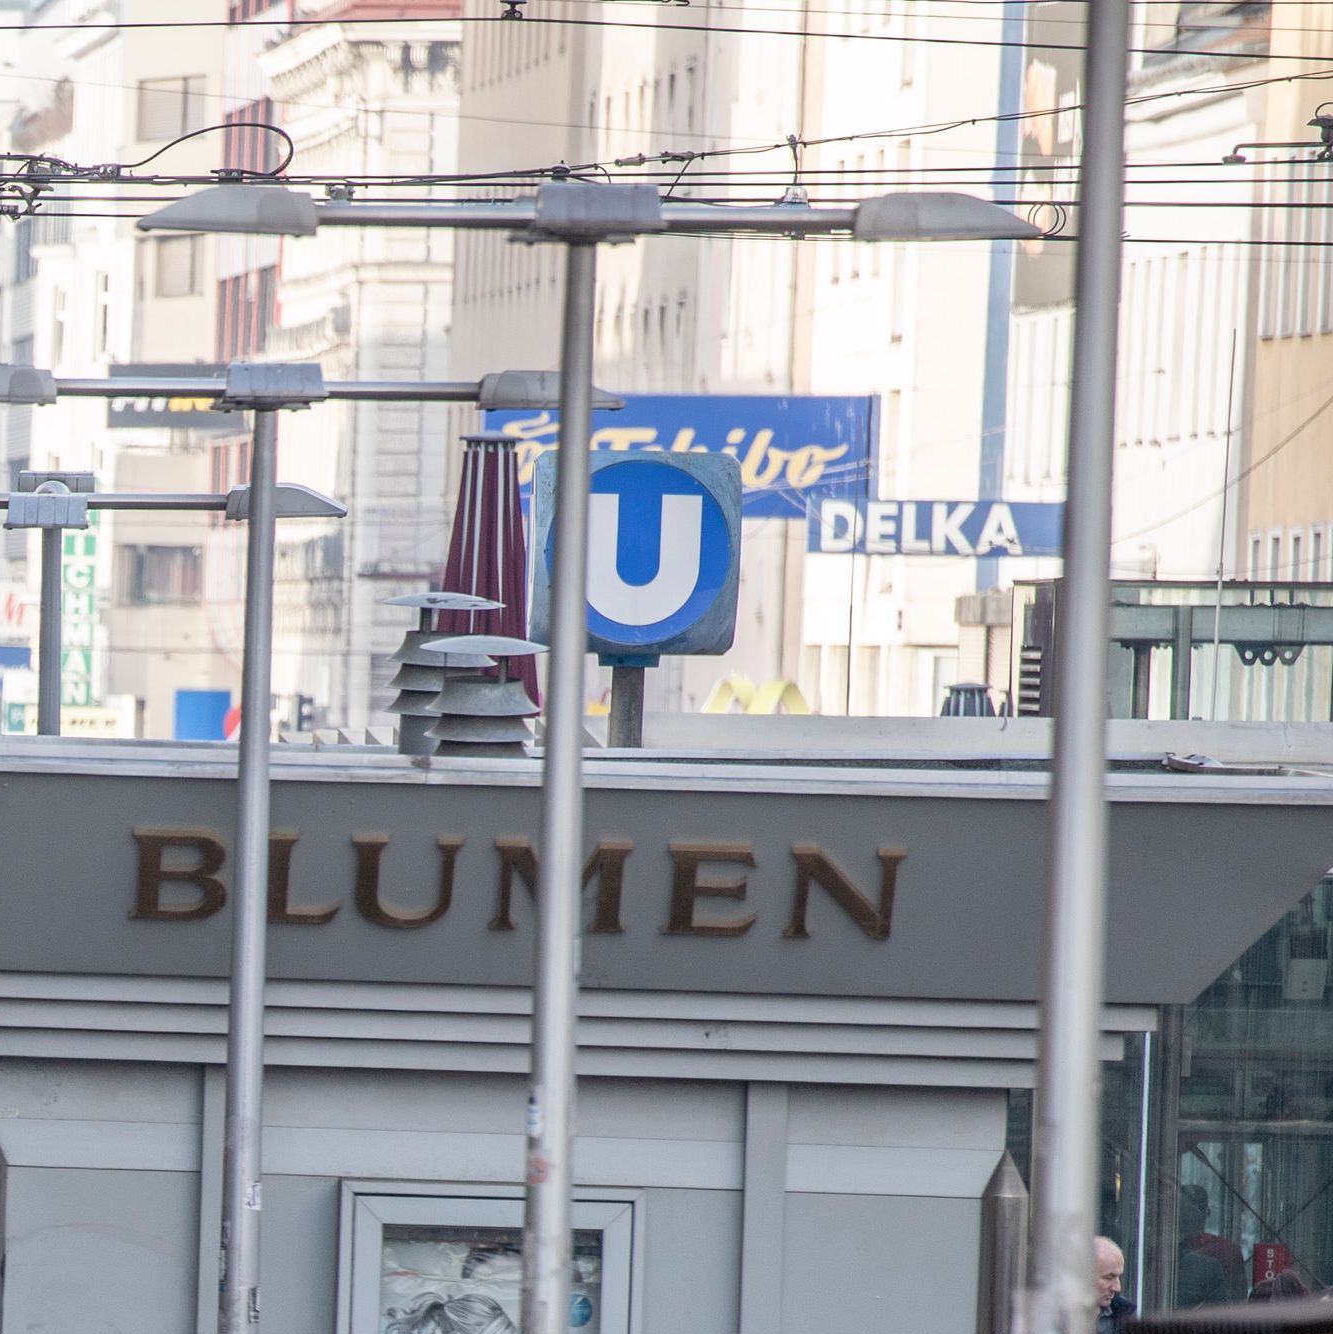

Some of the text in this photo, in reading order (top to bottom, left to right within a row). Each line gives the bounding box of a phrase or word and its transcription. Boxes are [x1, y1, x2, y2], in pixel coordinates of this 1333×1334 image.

[585, 492, 704, 627] U
[820, 500, 1024, 556] DELKA
[127, 827, 909, 941] BLUMEN
[1265, 1247, 1275, 1280] STO
